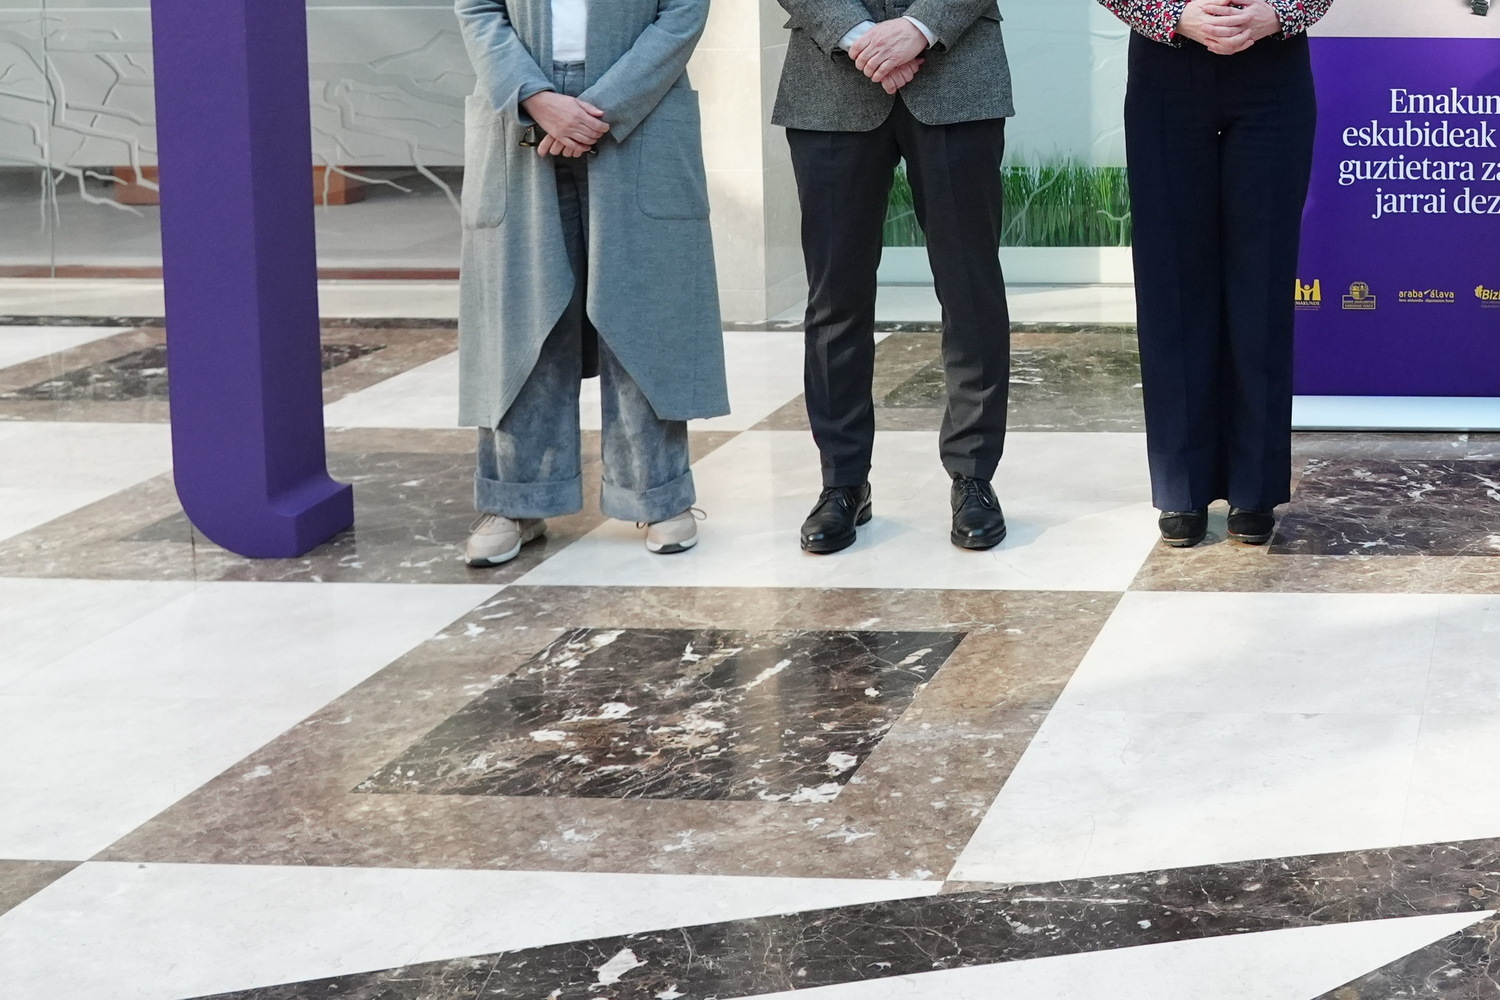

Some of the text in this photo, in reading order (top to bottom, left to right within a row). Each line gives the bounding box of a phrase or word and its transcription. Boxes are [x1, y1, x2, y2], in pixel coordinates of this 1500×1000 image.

[1342, 120, 1497, 148] eskubideak
[1338, 154, 1475, 186] guztietara
[1371, 187, 1447, 219] jarrai
